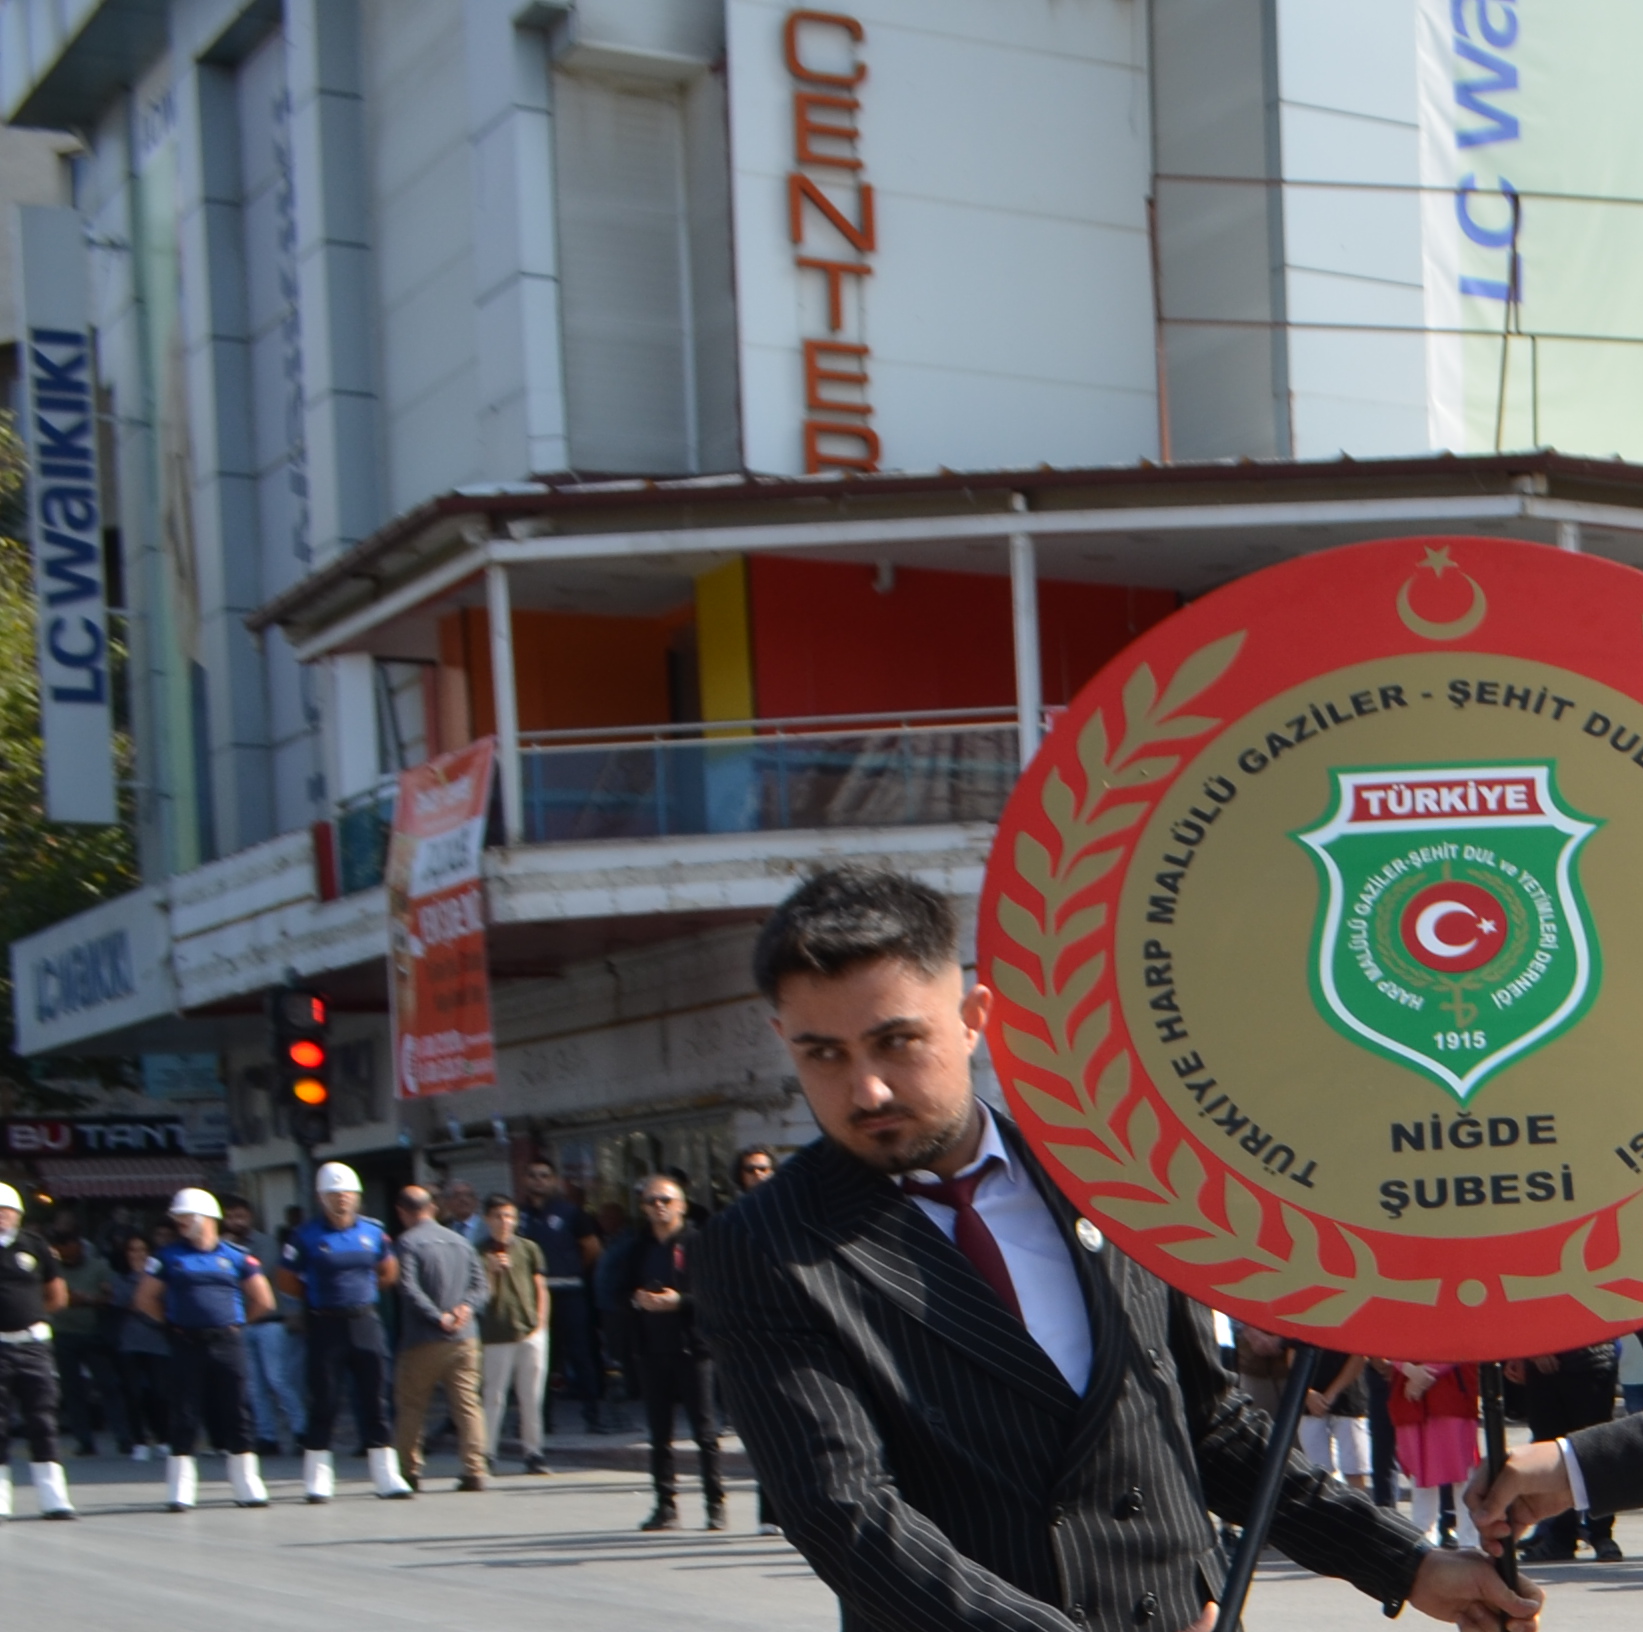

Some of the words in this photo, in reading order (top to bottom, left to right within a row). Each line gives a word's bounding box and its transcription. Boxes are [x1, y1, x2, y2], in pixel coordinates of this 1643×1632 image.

[784, 10, 880, 474] CENTER
[48, 616, 106, 705] LC
[1448, 678, 1575, 723] ŞEHİT
[1237, 682, 1409, 776] GAZİLER
[1361, 780, 1528, 815] TÜRKİYE
[1148, 774, 1238, 926] MALÜLÜ
[1463, 844, 1497, 868] DUL
[1499, 859, 1518, 877] ve
[1517, 870, 1559, 950] YETİMLERİ
[1143, 938, 1189, 1044] HARP
[1377, 977, 1425, 1012] HARP
[1490, 949, 1552, 1010] DERNEĞİ
[1433, 1031, 1487, 1050] 1915
[8, 1123, 71, 1149] BU
[1169, 1049, 1320, 1188] TÜRKİYE
[1390, 1112, 1557, 1153] NİĞDE
[1379, 1165, 1575, 1220] ŞUBESİ
